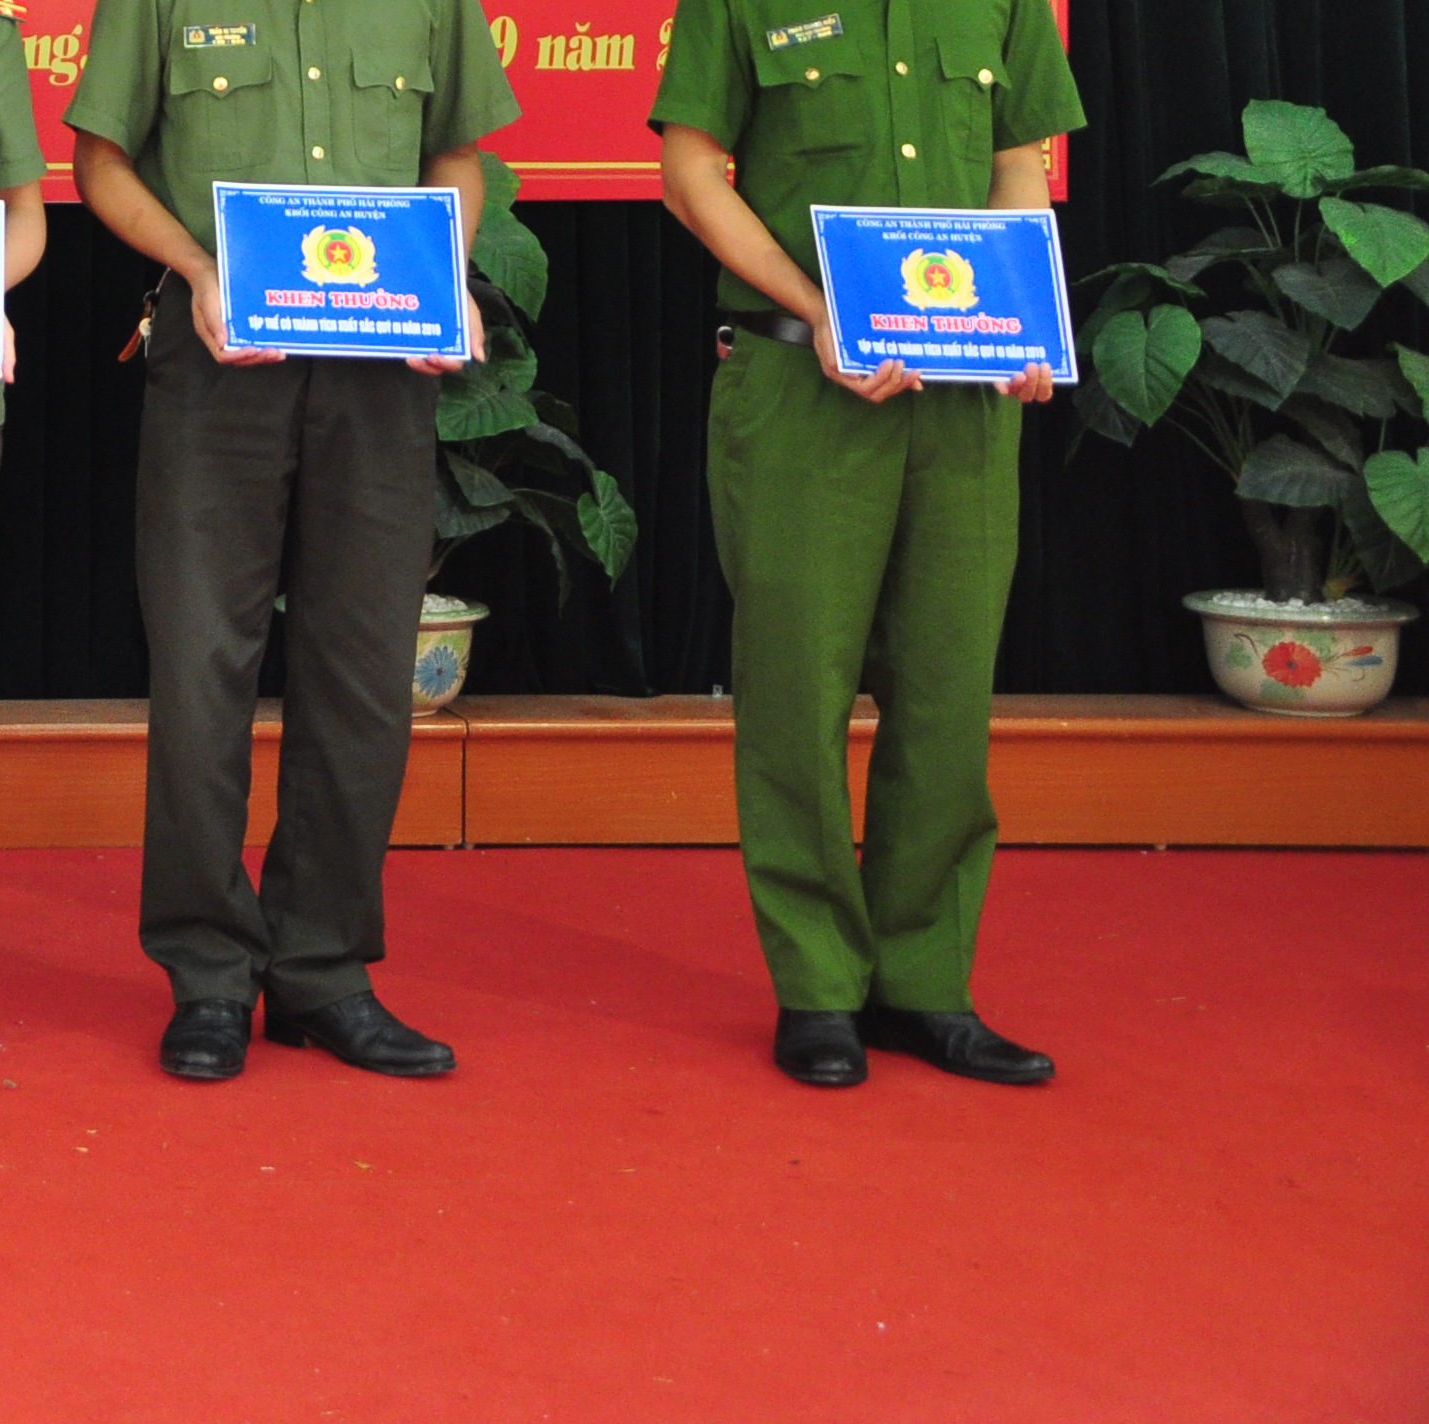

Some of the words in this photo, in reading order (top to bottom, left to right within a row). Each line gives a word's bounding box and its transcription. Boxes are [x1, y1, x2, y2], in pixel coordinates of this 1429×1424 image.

[535, 21, 635, 71] năm
[265, 289, 325, 306] KHEN
[329, 288, 420, 310] THƯỞNG
[871, 314, 928, 331] KHEN
[931, 312, 1022, 333] THƯỞNG
